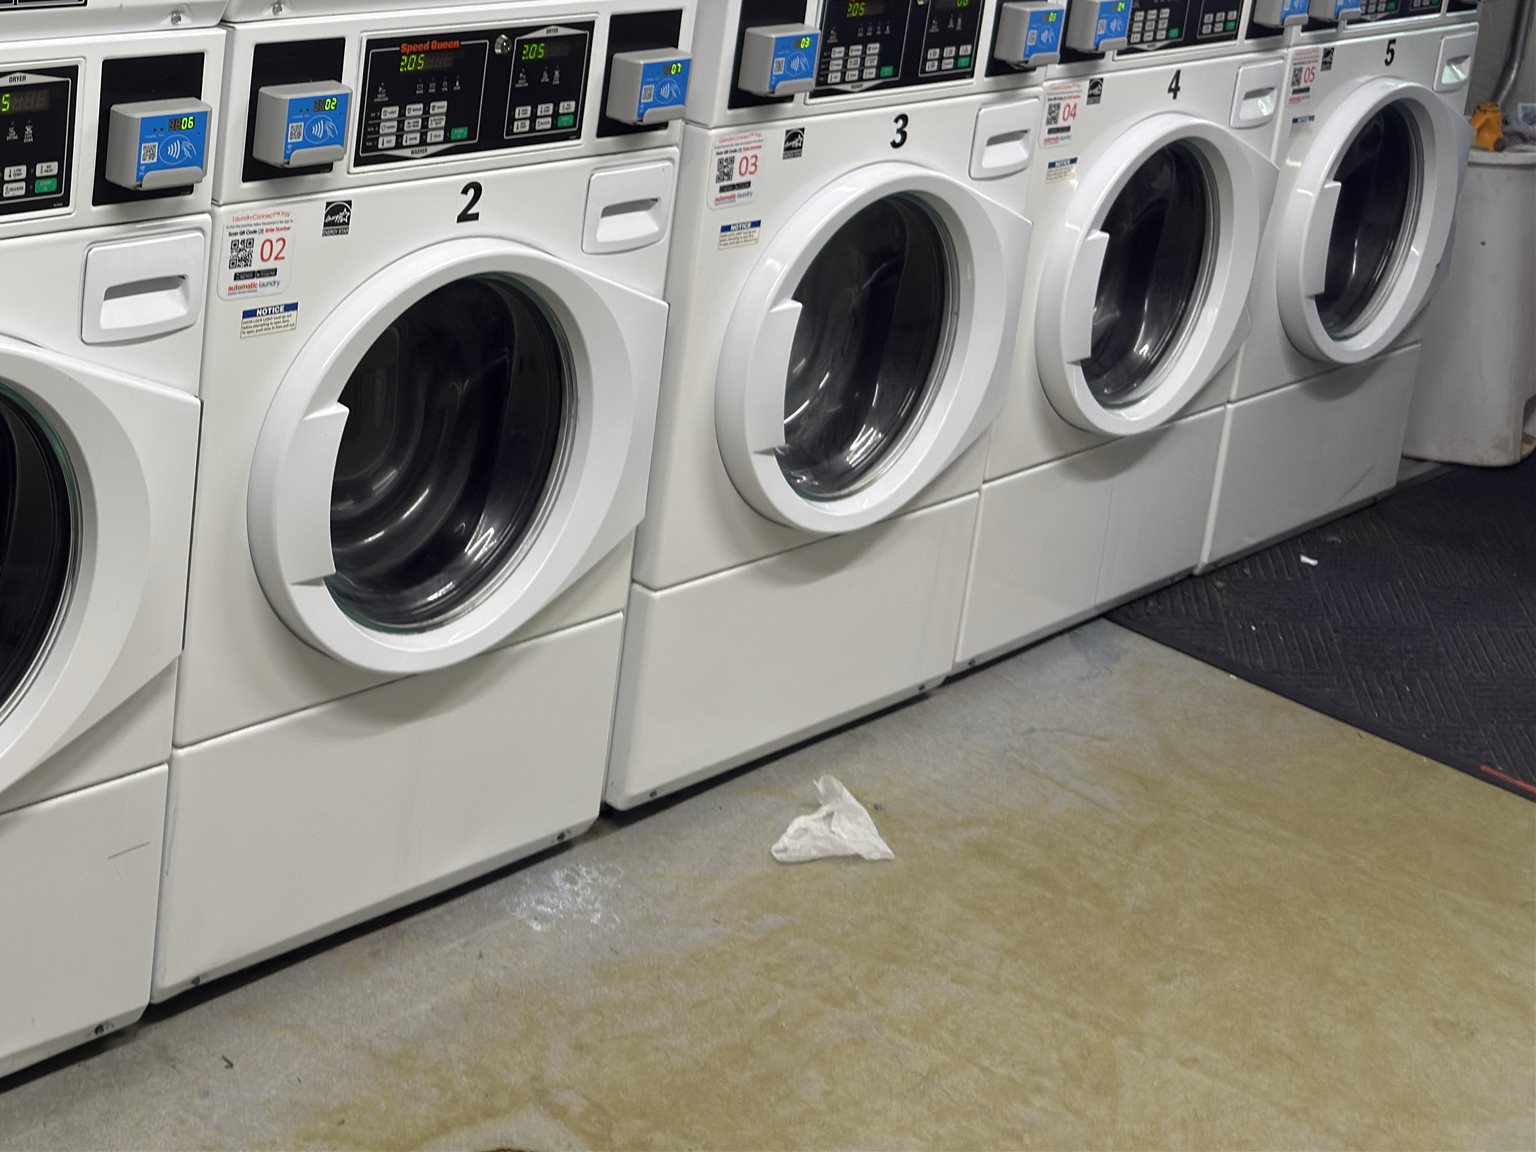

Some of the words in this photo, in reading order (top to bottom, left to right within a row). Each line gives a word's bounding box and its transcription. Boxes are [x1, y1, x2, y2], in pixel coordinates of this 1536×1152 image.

[401, 41, 430, 54] Speed
[431, 40, 460, 51] Queen
[801, 37, 810, 49] 03
[1385, 39, 1396, 66] 5
[671, 63, 681, 75] 07
[1304, 67, 1315, 84] 05
[1168, 69, 1181, 100] 4
[325, 98, 337, 111] 02
[1063, 103, 1077, 122] 04
[182, 116, 194, 129] 06
[890, 114, 909, 149] 3
[739, 154, 758, 177] 03
[457, 182, 482, 223] 2
[731, 222, 751, 231] NOTICE
[260, 237, 286, 262] 02
[228, 282, 257, 292] automatic
[259, 279, 280, 288] laundry
[256, 305, 284, 316] NOTICE
